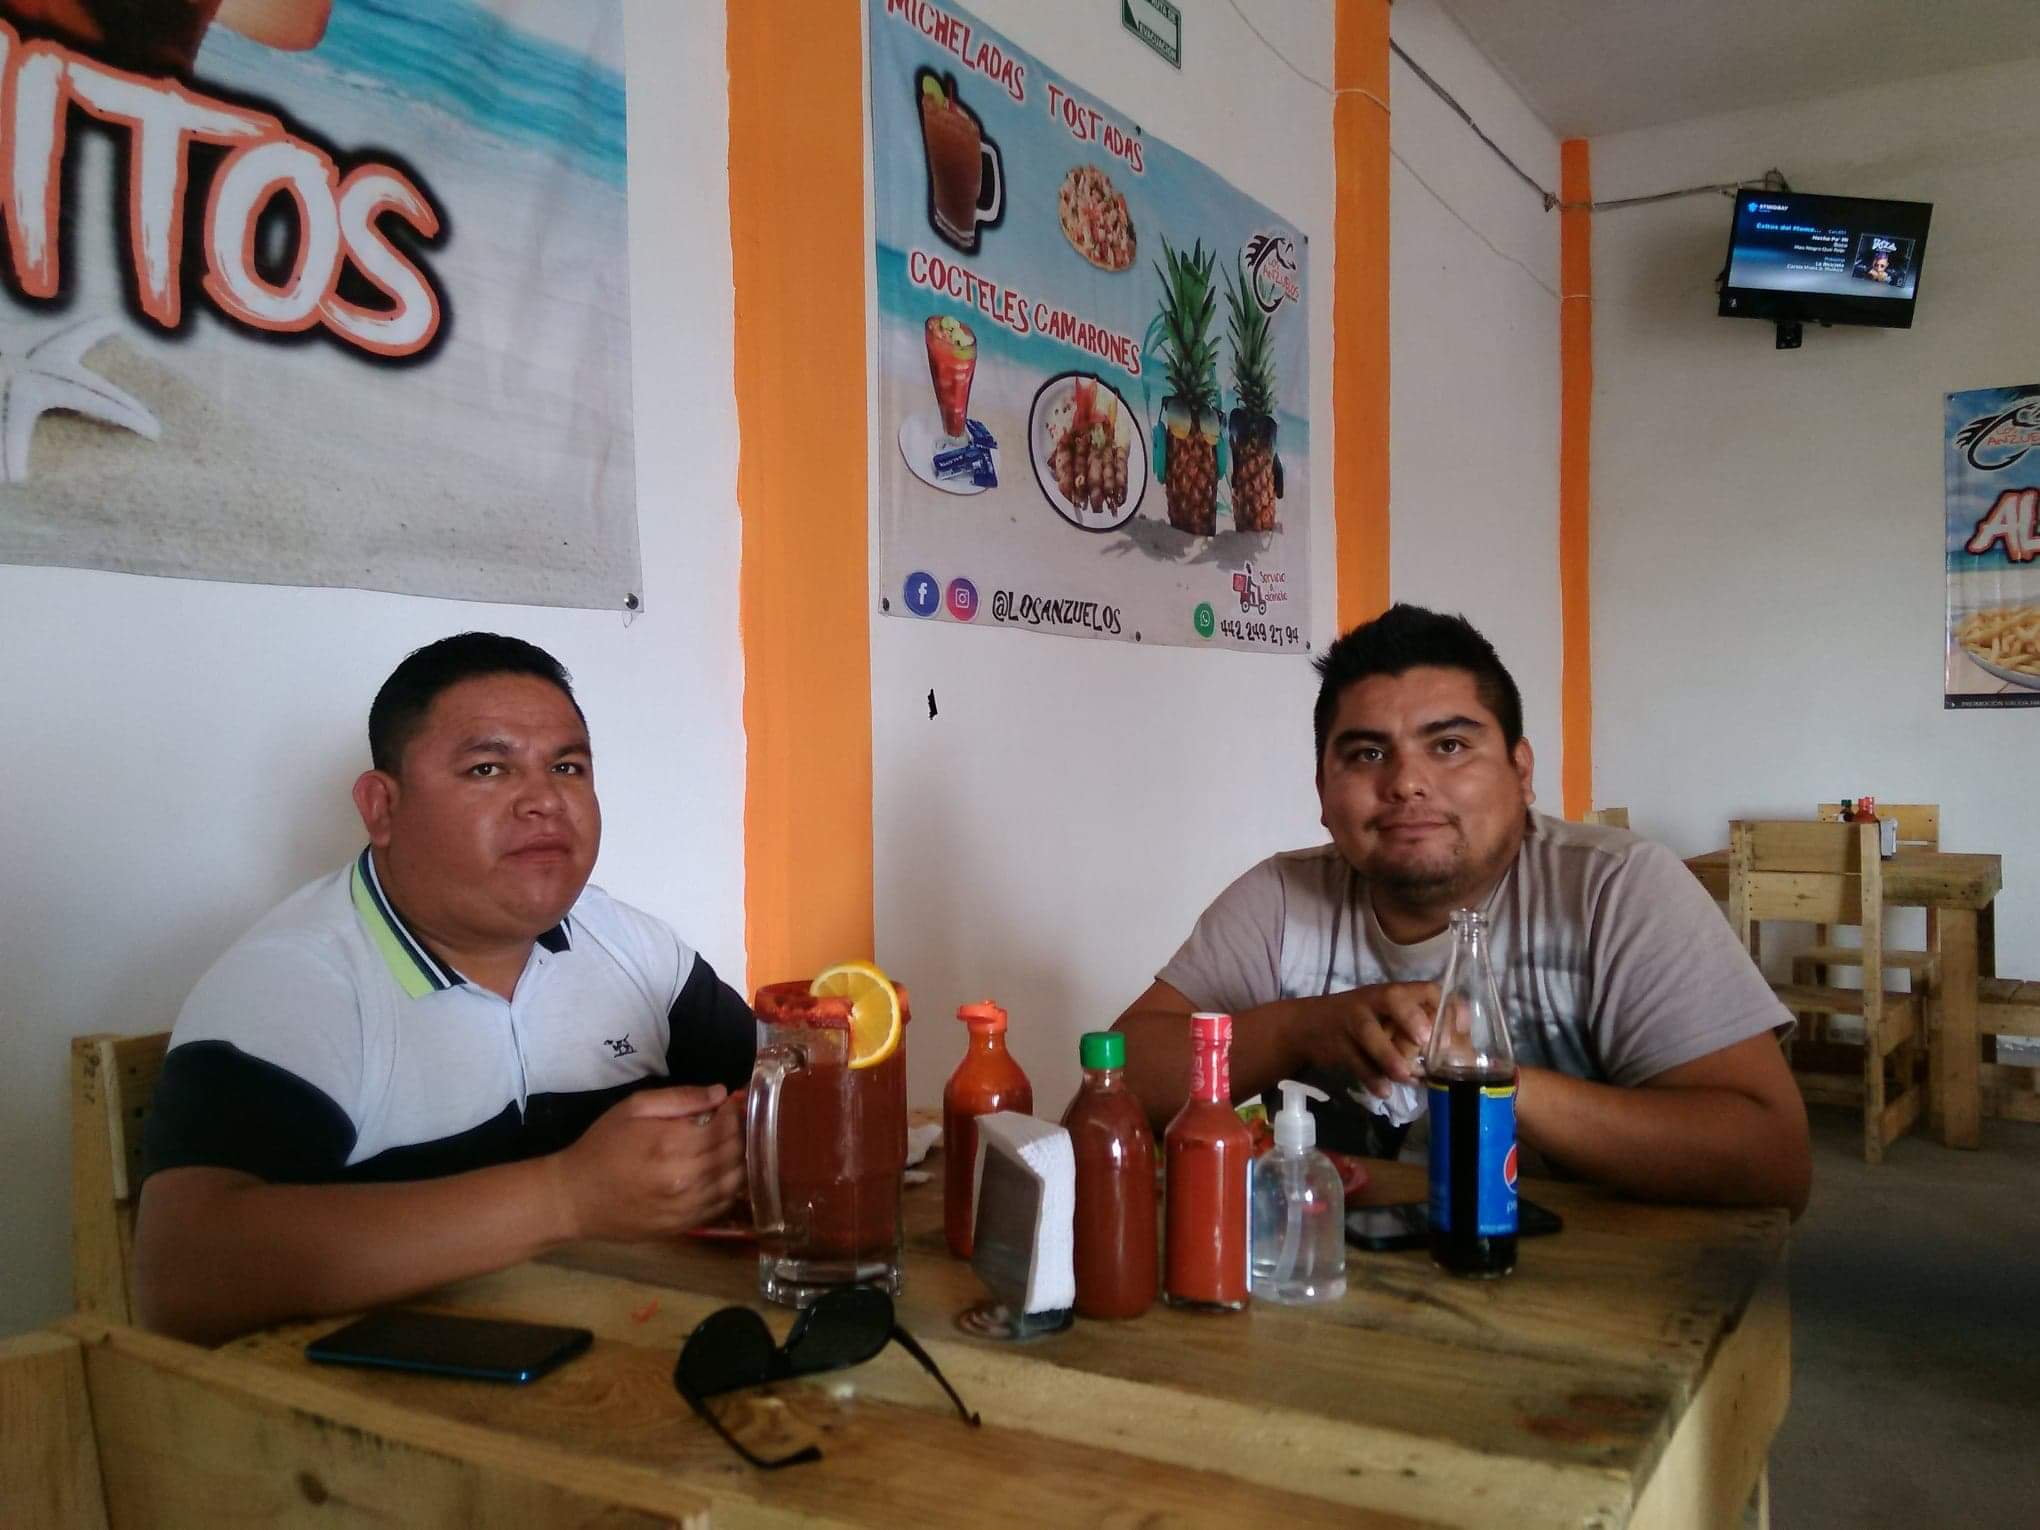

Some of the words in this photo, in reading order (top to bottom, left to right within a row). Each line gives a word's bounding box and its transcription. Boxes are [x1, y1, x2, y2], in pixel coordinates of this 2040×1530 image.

[886, 0, 1025, 101] MICHELADAS
[1048, 84, 1143, 172] TOSTADAS
[0, 18, 440, 356] ITOS
[910, 251, 1029, 333] COCTELES
[1034, 303, 1140, 376] CAMARONES
[992, 590, 1121, 634] @LOSANZUELOS
[1221, 619, 1244, 640] 442
[1246, 622, 1267, 641] 249
[1269, 624, 1283, 647] 27
[1285, 625, 1299, 644] 94
